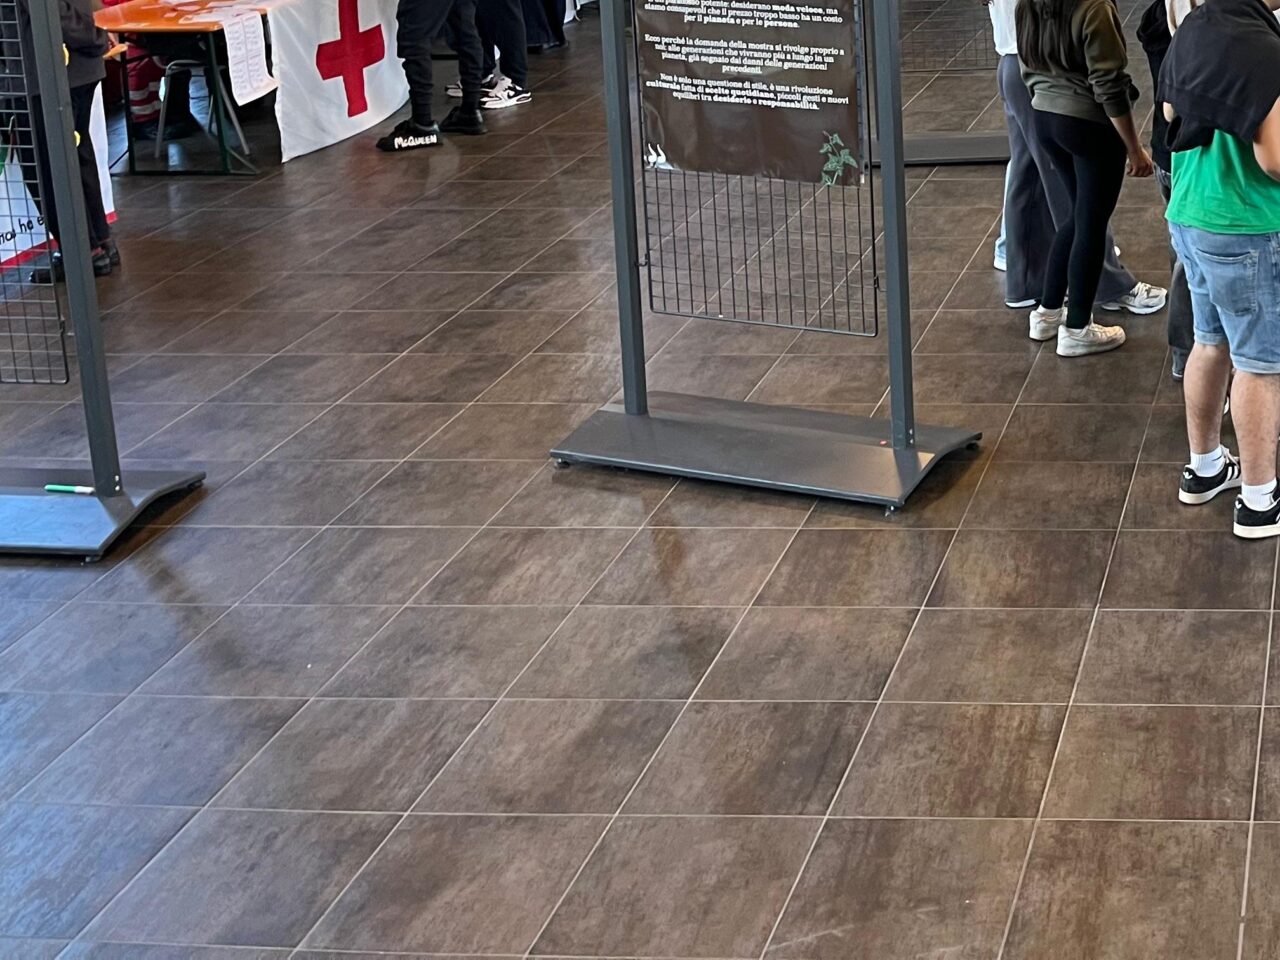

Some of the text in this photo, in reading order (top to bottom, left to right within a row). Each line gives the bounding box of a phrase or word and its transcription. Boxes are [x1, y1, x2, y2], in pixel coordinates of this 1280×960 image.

[644, 2, 666, 11] siamo
[667, 5, 706, 14] consapevoli
[707, 7, 720, 15] che
[728, 9, 753, 18] prezzo
[753, 10, 778, 20] troppo
[779, 11, 800, 20] basso
[823, 15, 843, 23] costo
[730, 0, 771, 10] desiderano
[772, 4, 795, 12] moda
[684, 15, 696, 23] per
[703, 15, 735, 24] pianeta
[741, 18, 755, 27] per
[645, 34, 660, 42] Ecco
[661, 36, 685, 45] perché
[694, 38, 727, 47] domanda
[729, 40, 747, 48] della
[748, 42, 774, 50] mostra
[783, 44, 809, 55] rivolge
[810, 47, 838, 57] proprio
[646, 80, 680, 90] culturale
[681, 83, 696, 91] fatta
[705, 86, 729, 94] scelte
[777, 92, 801, 101] piccoli
[803, 94, 820, 103] gesti
[828, 96, 849, 104] nuovi
